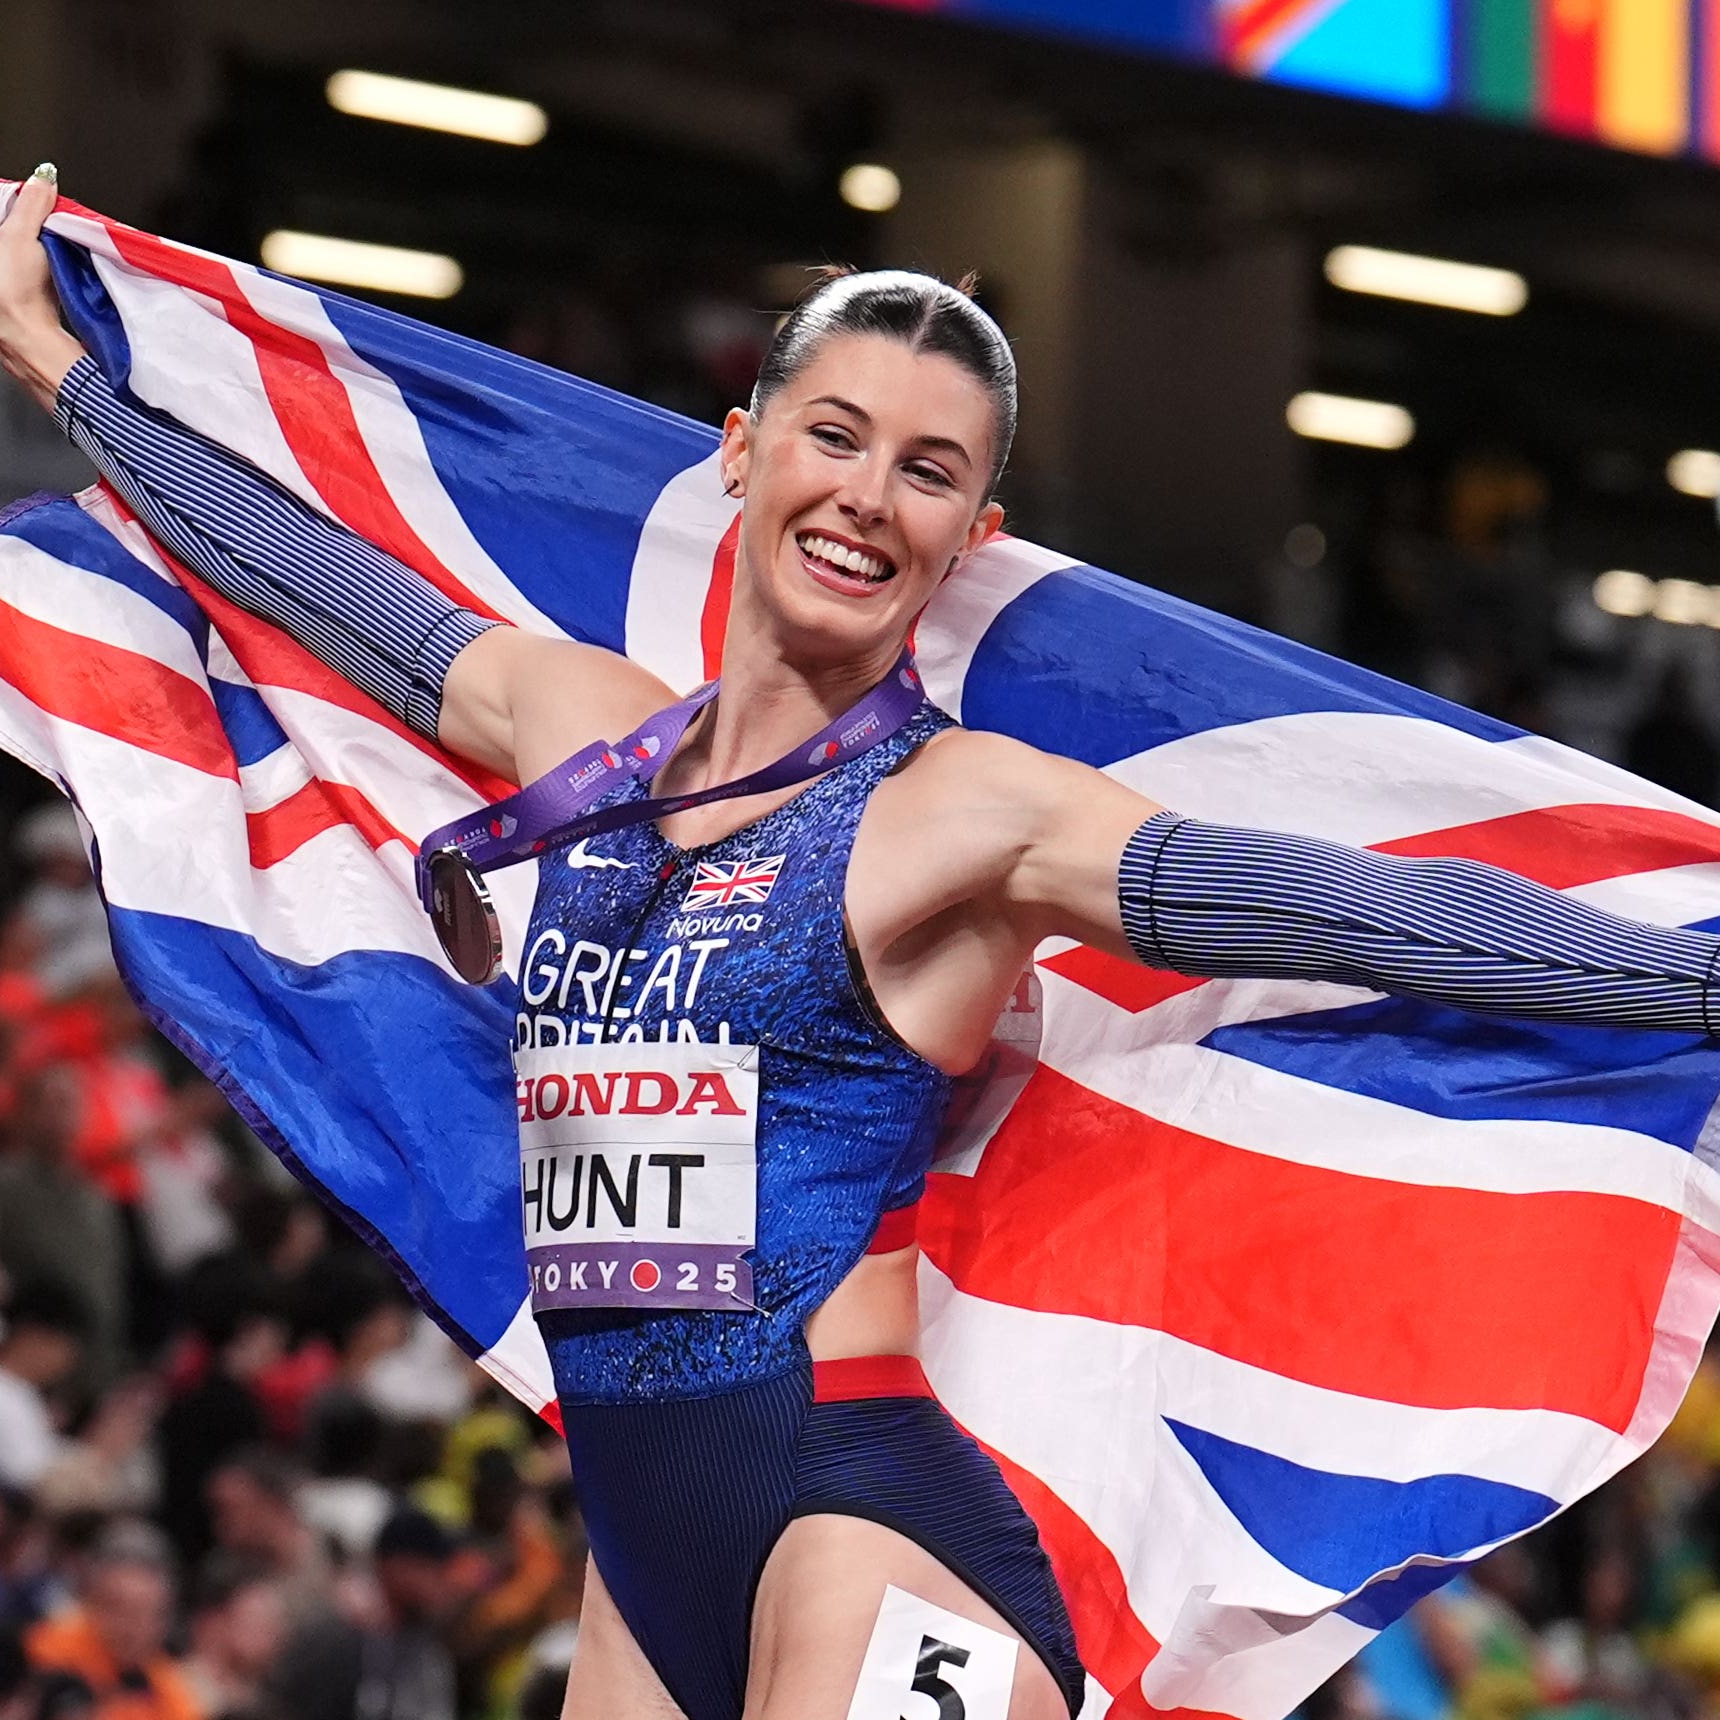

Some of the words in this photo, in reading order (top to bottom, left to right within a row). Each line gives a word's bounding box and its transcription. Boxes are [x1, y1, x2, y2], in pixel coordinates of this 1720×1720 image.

[665, 913, 764, 939] Novuna
[523, 928, 730, 1018] GREAT
[516, 1072, 747, 1123] HONDA
[523, 1153, 705, 1236] HUNT
